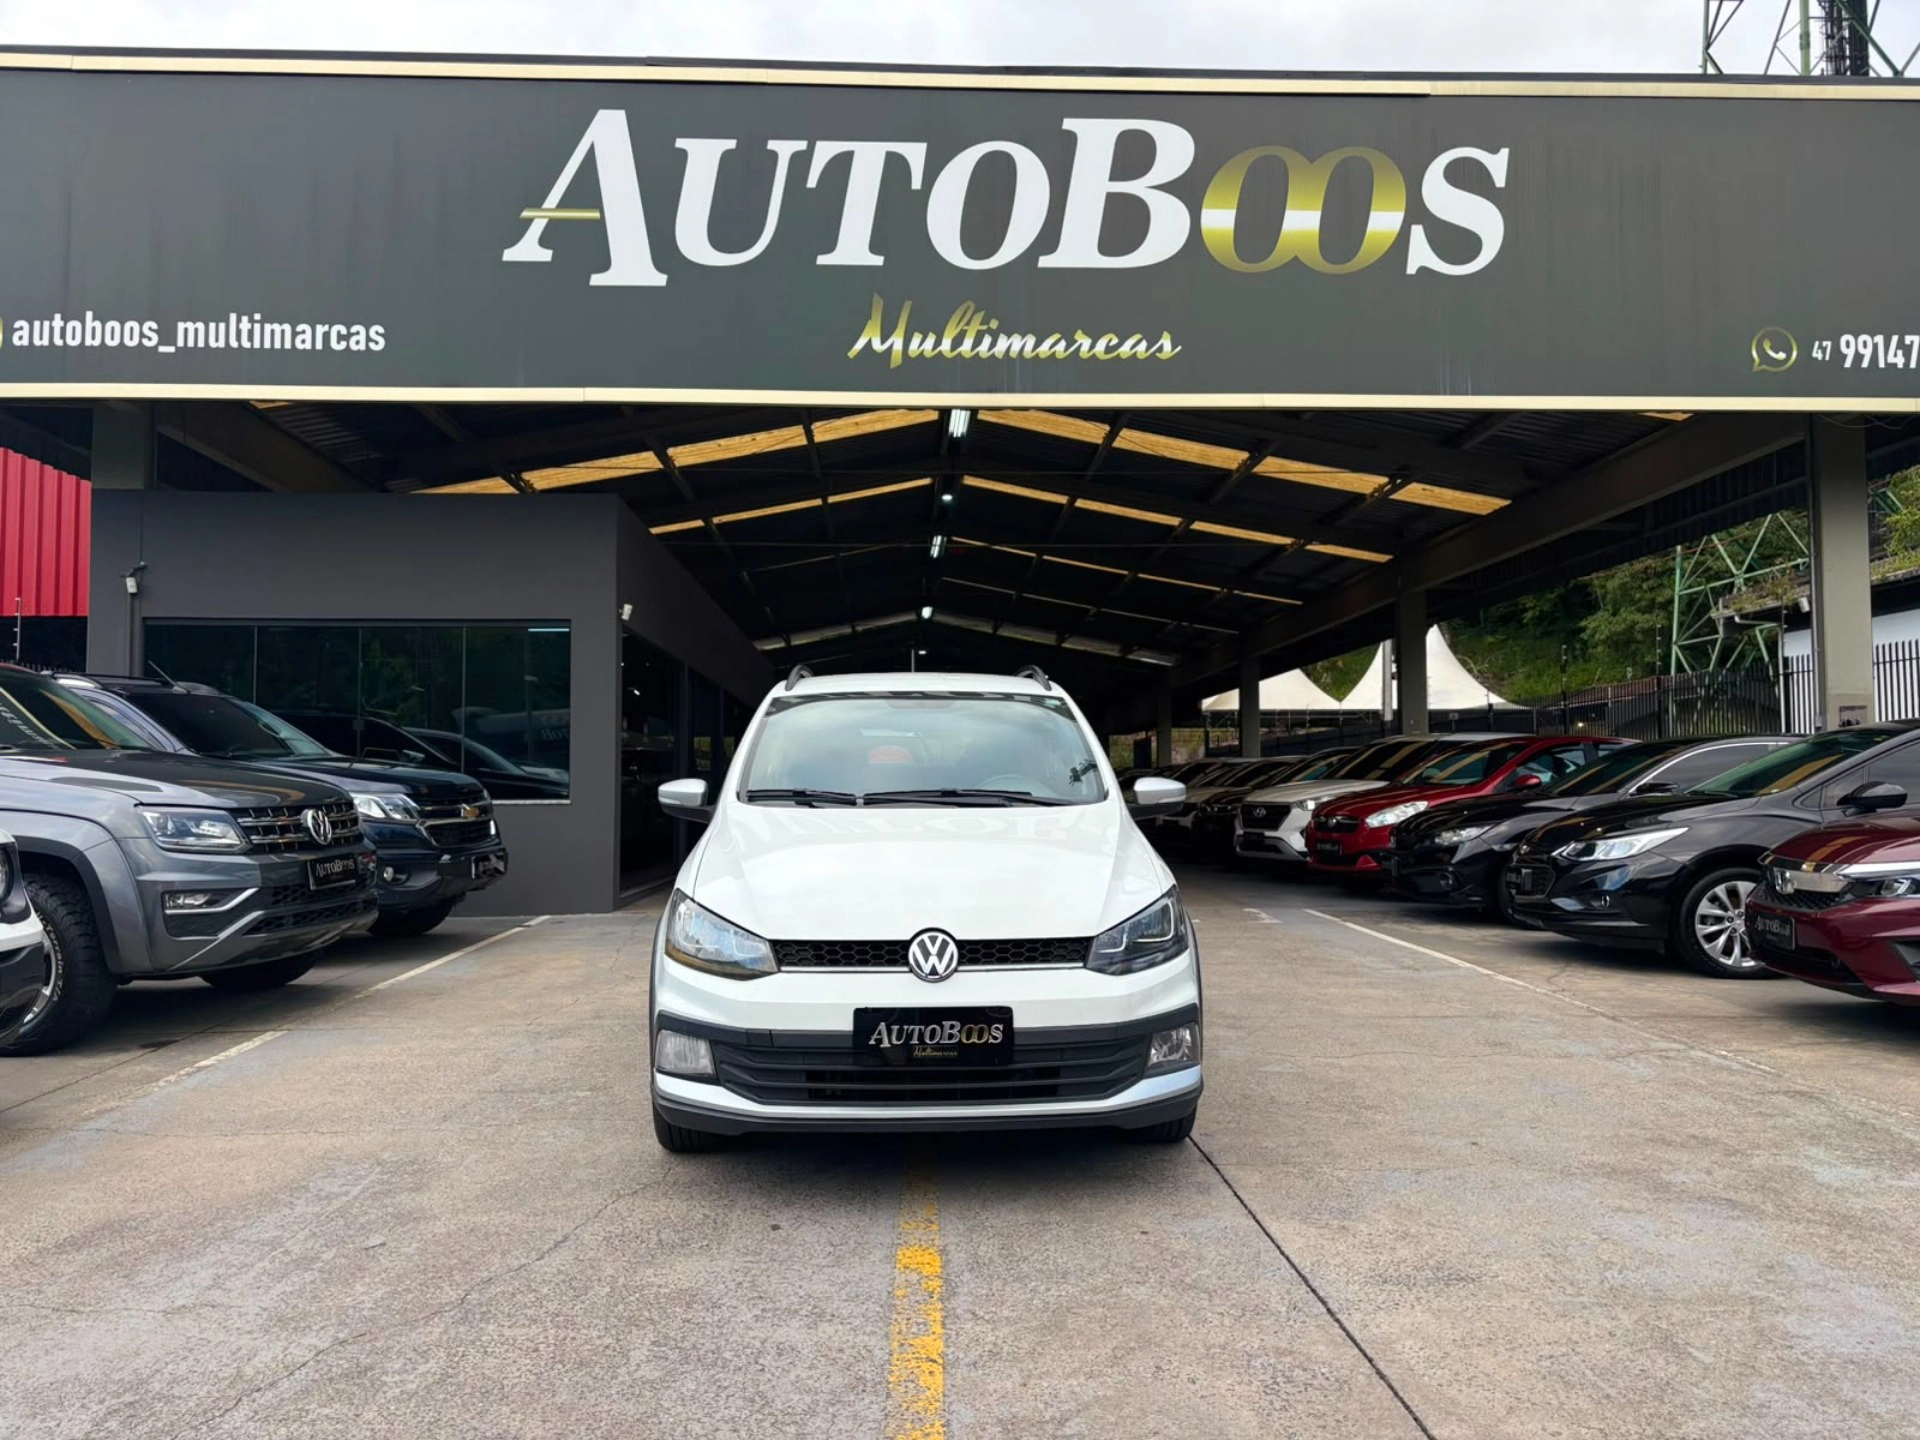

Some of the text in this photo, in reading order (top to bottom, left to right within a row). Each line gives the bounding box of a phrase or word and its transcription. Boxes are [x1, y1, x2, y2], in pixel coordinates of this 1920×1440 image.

[502, 109, 1511, 288] AUTOBOOS
[12, 311, 386, 351] autoboos_multimarcas
[847, 293, 1183, 369] Multimarcas
[1812, 334, 1920, 369] 47 99147
